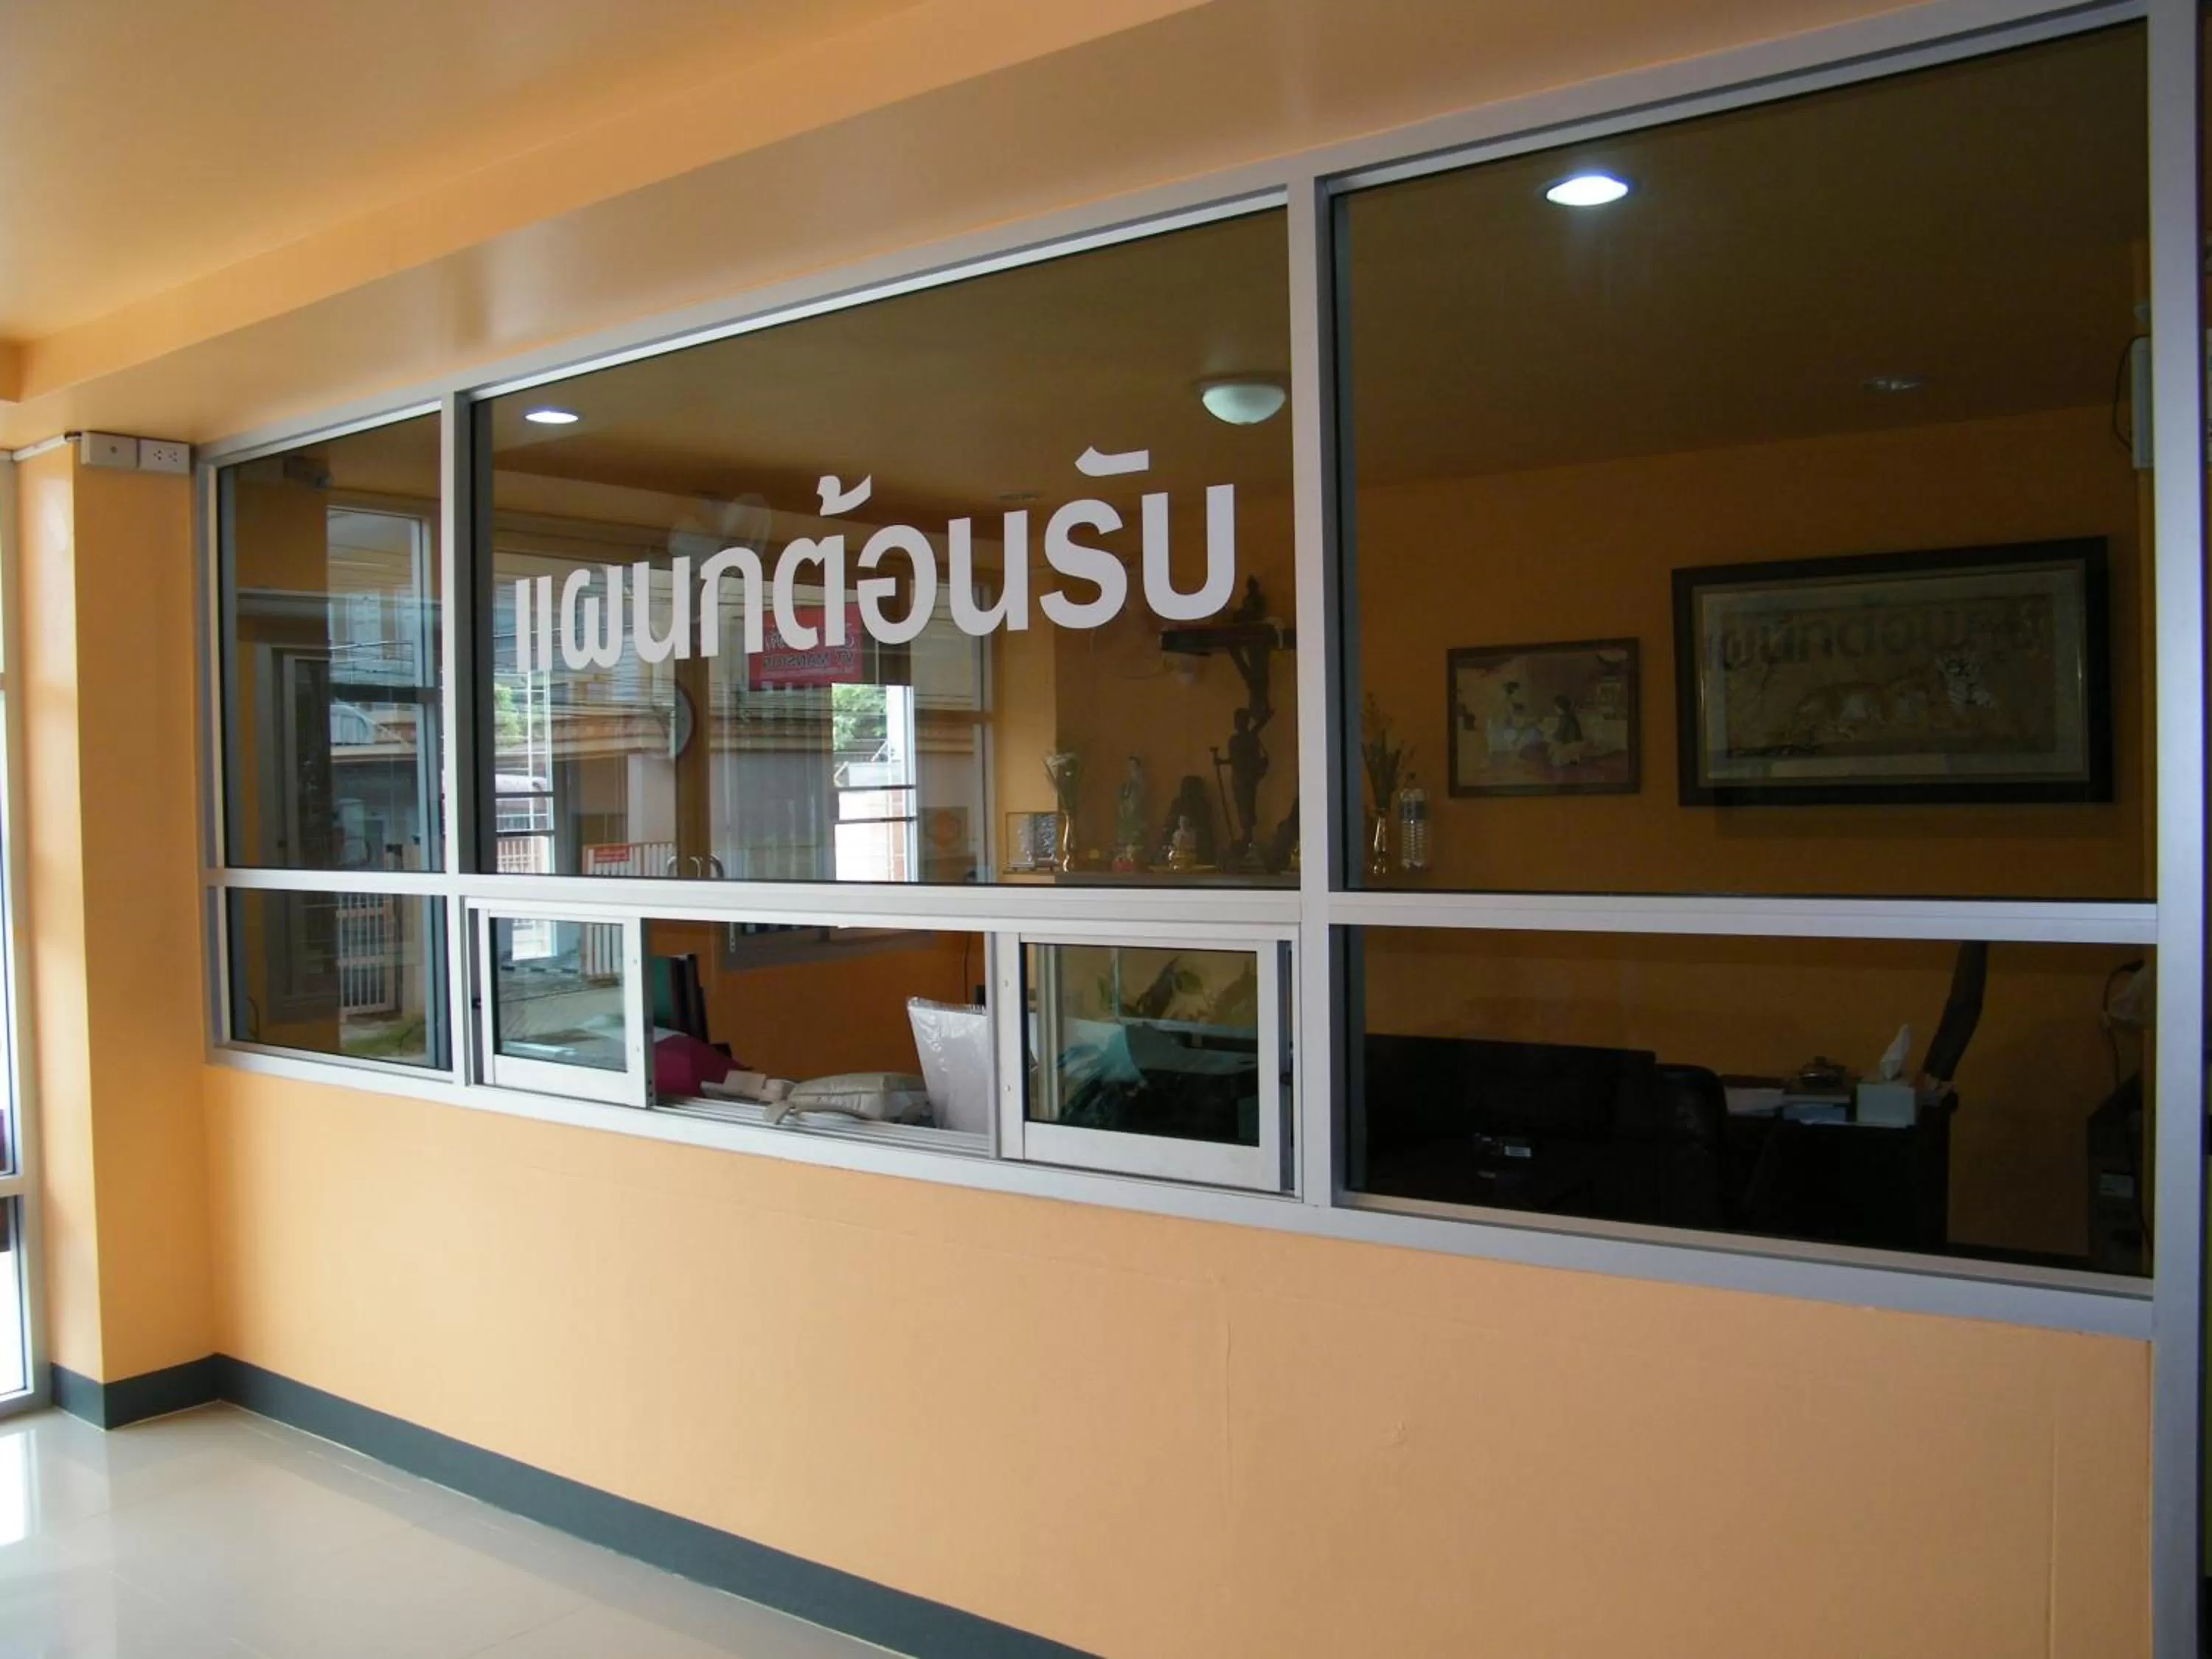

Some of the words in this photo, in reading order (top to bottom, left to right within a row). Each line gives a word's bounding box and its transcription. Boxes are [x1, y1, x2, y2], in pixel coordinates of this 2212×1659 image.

[516, 446, 1235, 673] แผนกต้อนรับ
